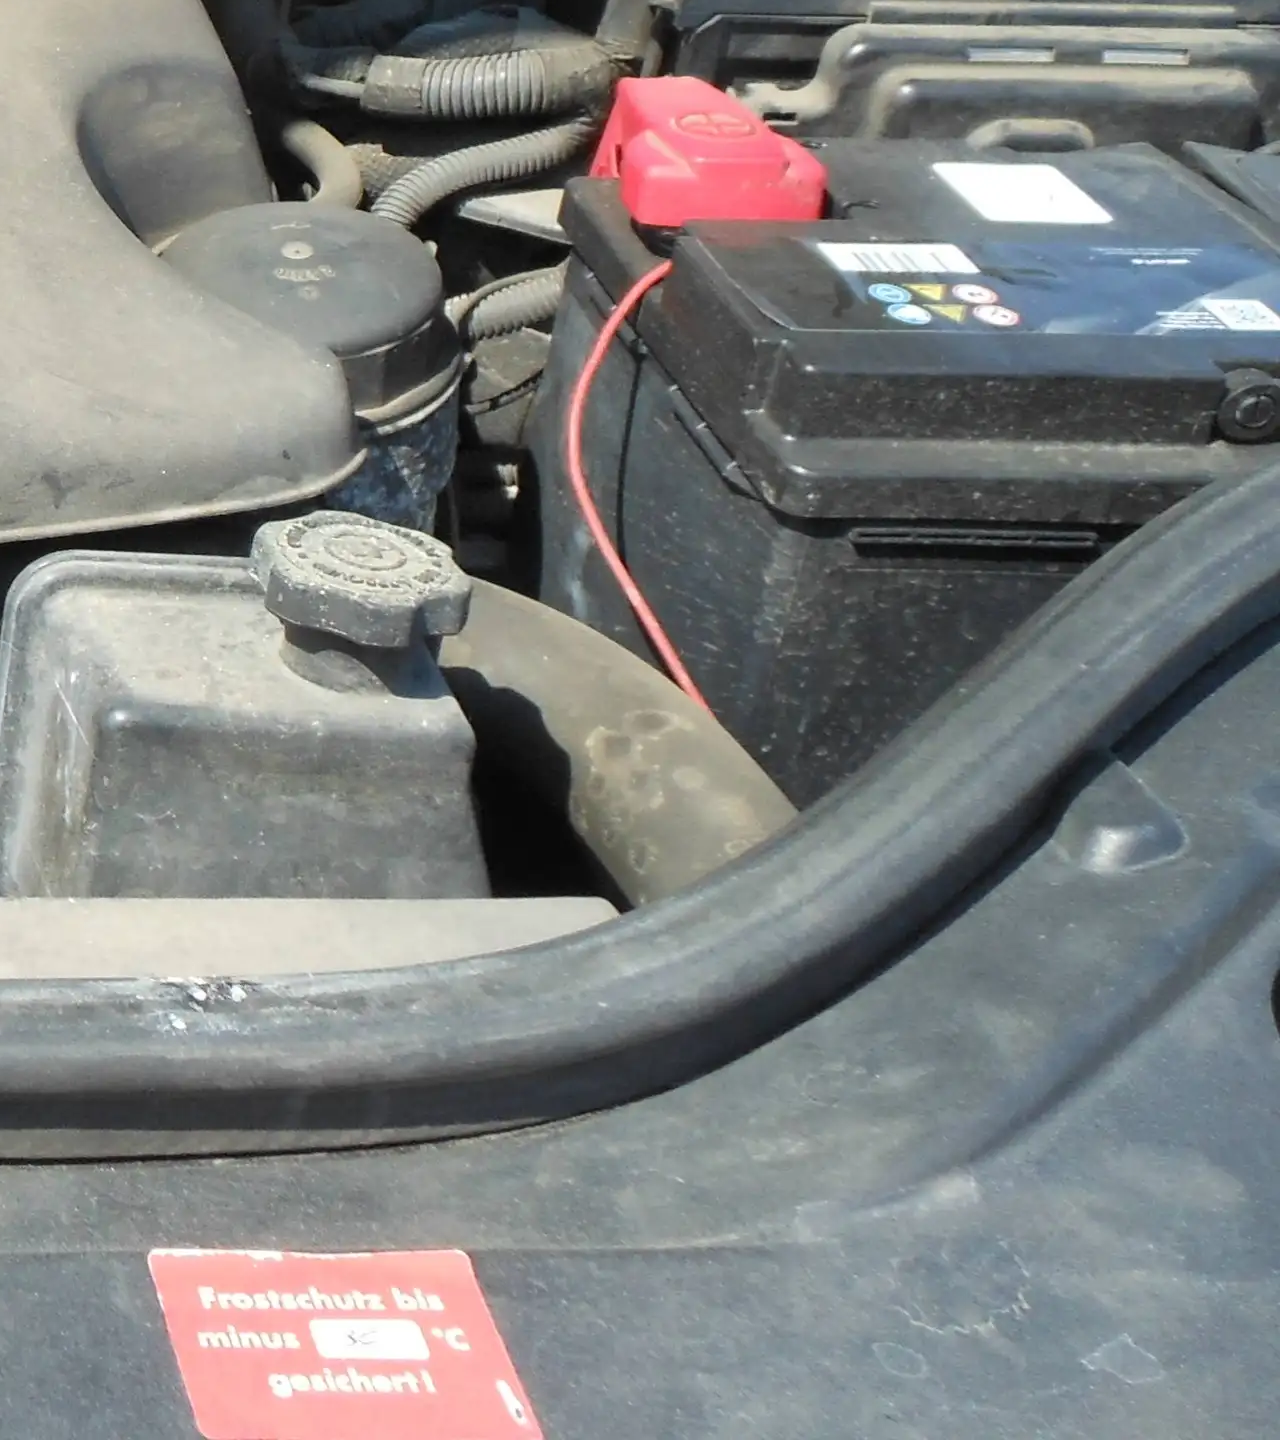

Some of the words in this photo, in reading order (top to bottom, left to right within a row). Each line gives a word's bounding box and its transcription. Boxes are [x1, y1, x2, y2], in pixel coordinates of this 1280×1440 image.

[197, 1285, 386, 1312] Frostschutz
[392, 1286, 445, 1312] bis
[197, 1325, 301, 1350] minus
[431, 1326, 471, 1352] °C
